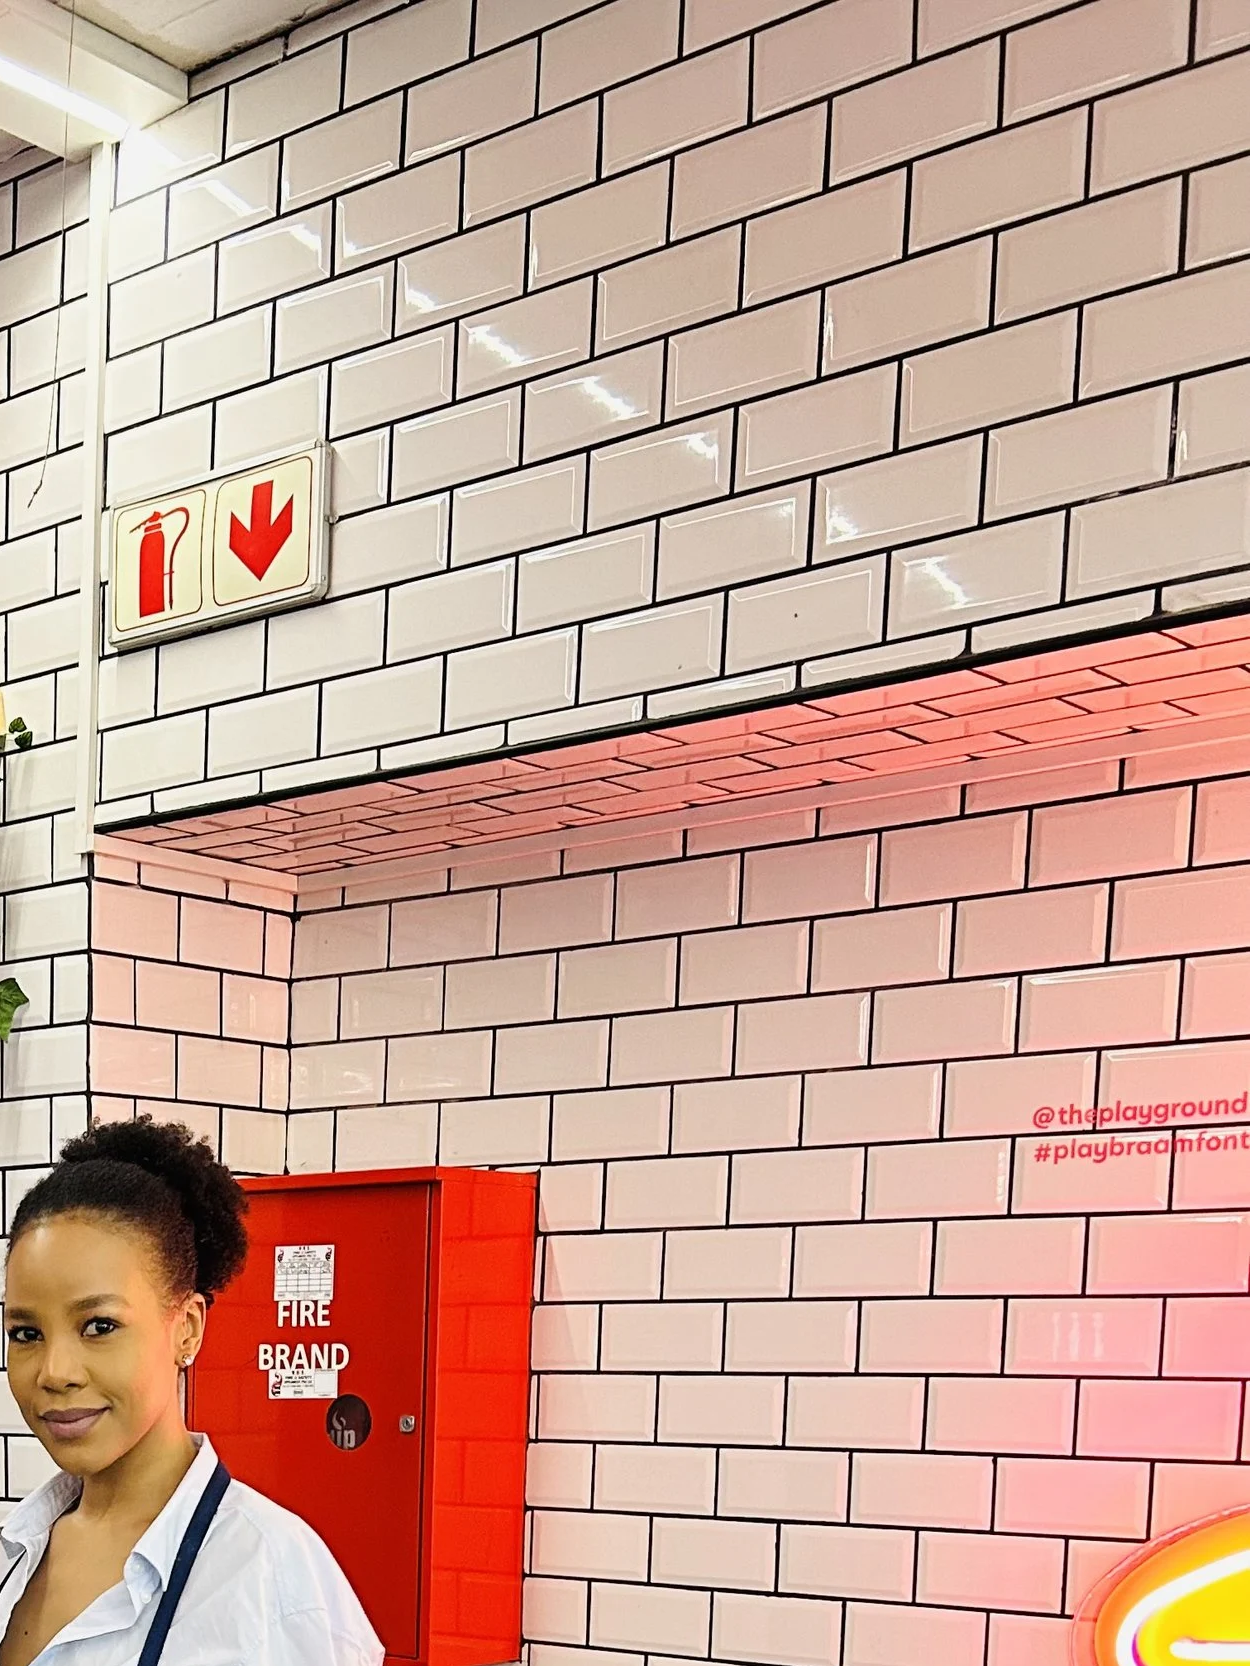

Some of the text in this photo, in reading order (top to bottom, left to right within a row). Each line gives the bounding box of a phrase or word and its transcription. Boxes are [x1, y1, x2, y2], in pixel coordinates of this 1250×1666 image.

[1033, 1091, 1248, 1129] @theplayground
[1034, 1131, 1250, 1165] #playbraamfont
[277, 1300, 331, 1327] FIRE
[258, 1343, 350, 1370] BRAND
